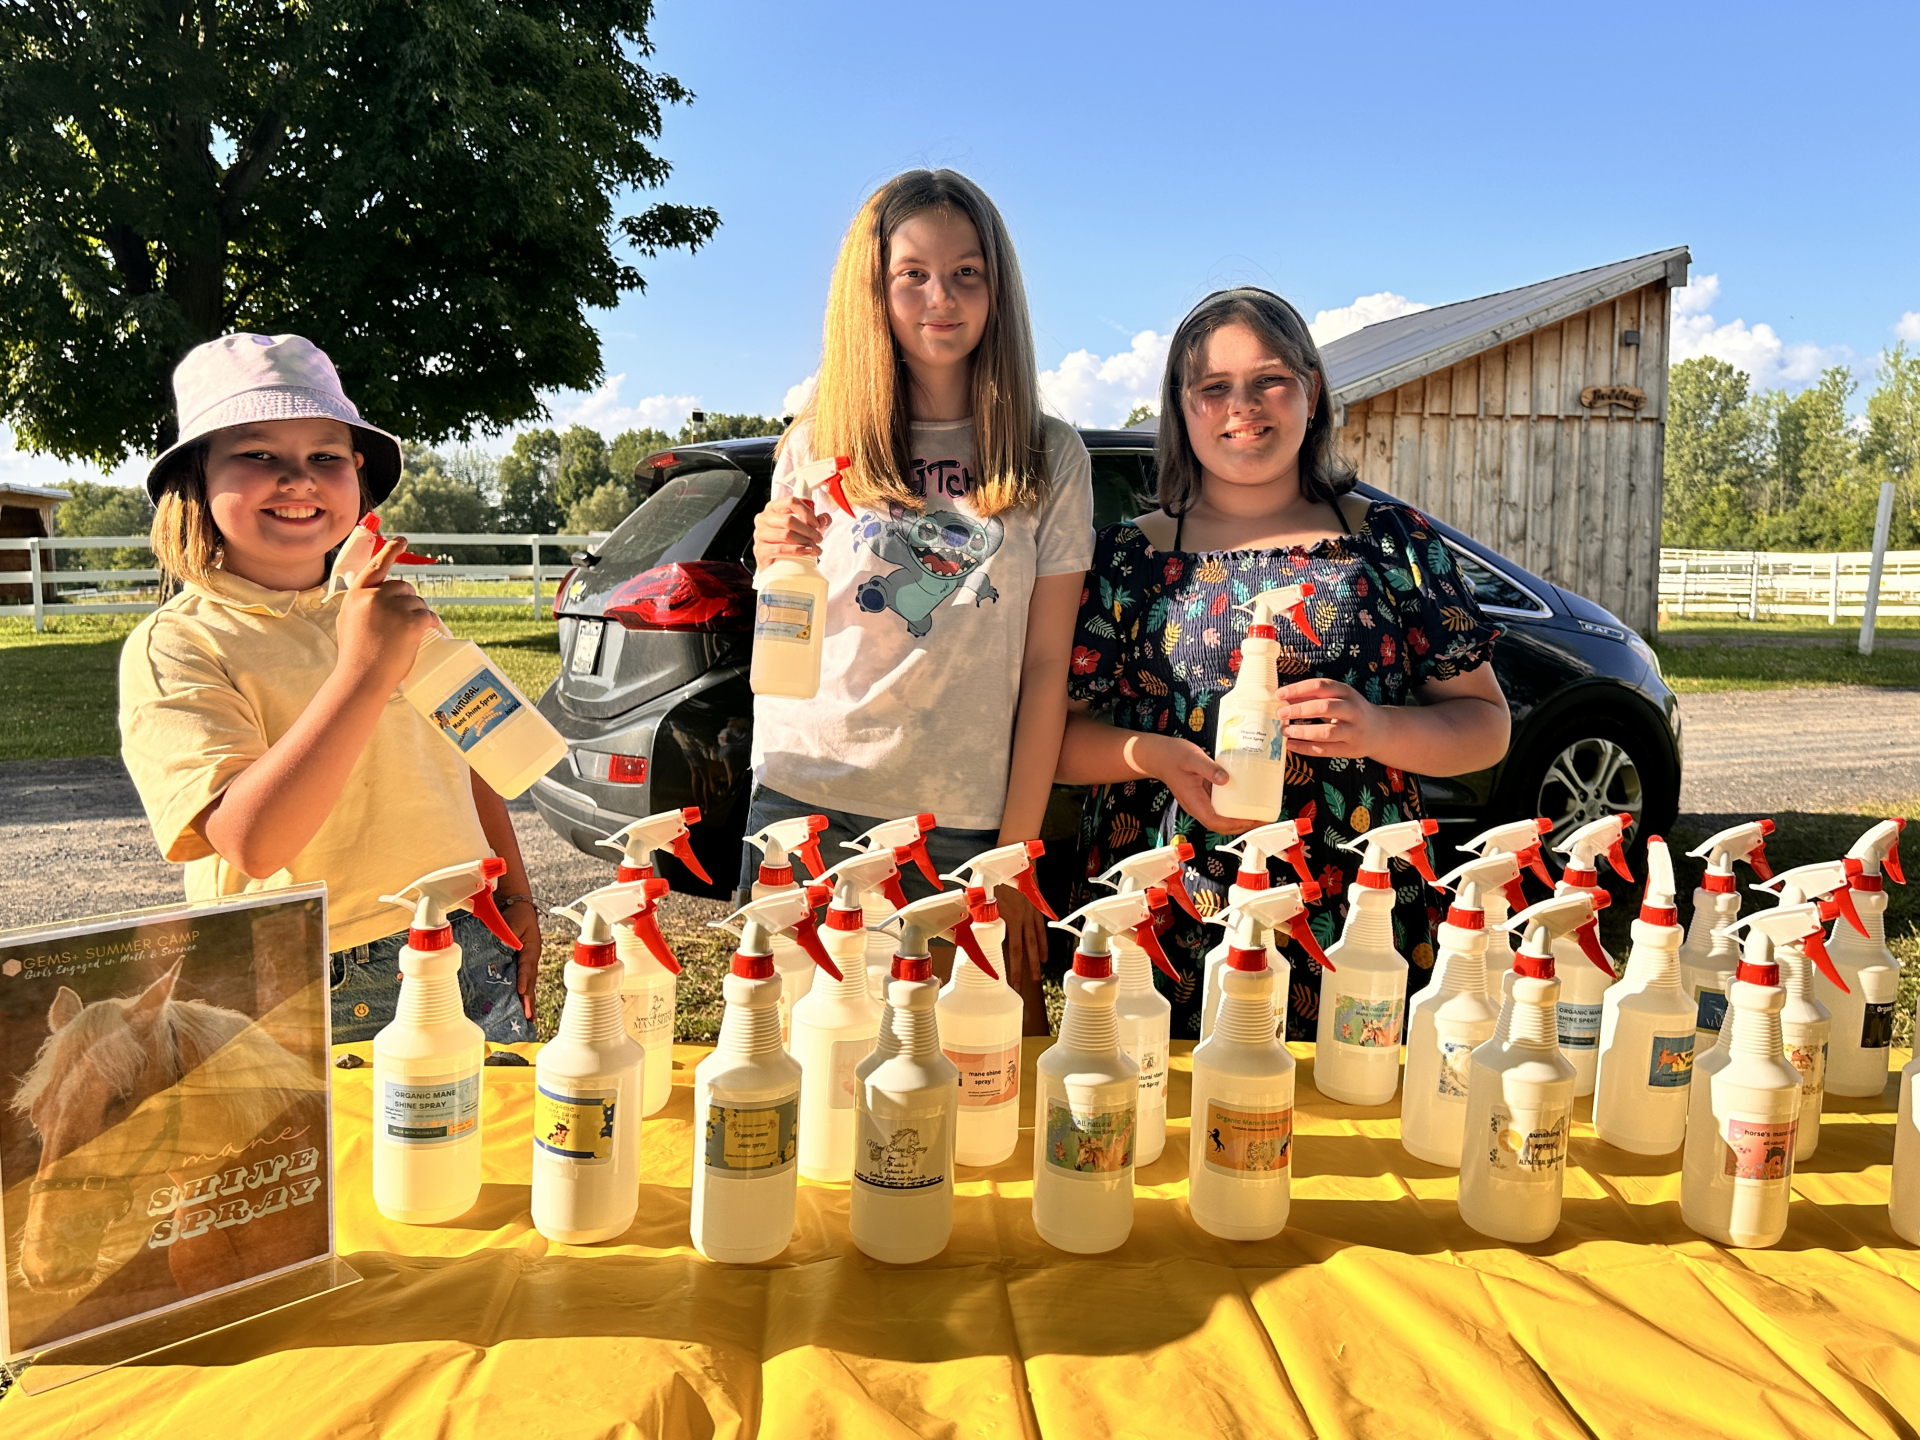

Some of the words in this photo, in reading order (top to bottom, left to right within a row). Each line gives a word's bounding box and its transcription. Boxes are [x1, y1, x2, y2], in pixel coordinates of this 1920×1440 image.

[450, 686, 480, 717] NATURAL
[452, 716, 467, 730] Mane
[465, 704, 481, 719] Shine
[479, 692, 498, 707] Spray
[23, 952, 79, 970] GEMS+
[86, 938, 151, 960] SUMMER
[157, 930, 200, 947] CAMP
[24, 967, 53, 980] Girls
[55, 958, 101, 976] Engaged
[104, 957, 117, 966] in
[119, 950, 146, 964] Math
[149, 949, 157, 959] &
[161, 943, 198, 957] Science
[1559, 1007, 1588, 1015] ORGANIC
[395, 1091, 431, 1099] ORGANIC
[433, 1089, 456, 1099] MANE
[394, 1101, 418, 1109] SHINE
[419, 1101, 447, 1110] SPRAY
[1216, 1113, 1241, 1124] Organic
[734, 1131, 754, 1139] Organic
[1744, 1129, 1770, 1137] horse's
[182, 1125, 311, 1167] mane
[752, 1142, 766, 1150] spray
[866, 1139, 884, 1151] Mane
[886, 1144, 905, 1153] Shine
[906, 1144, 928, 1155] Spray
[1534, 1142, 1554, 1150] spray
[147, 1147, 320, 1217] SHINE
[148, 1176, 321, 1249] SPRAY
